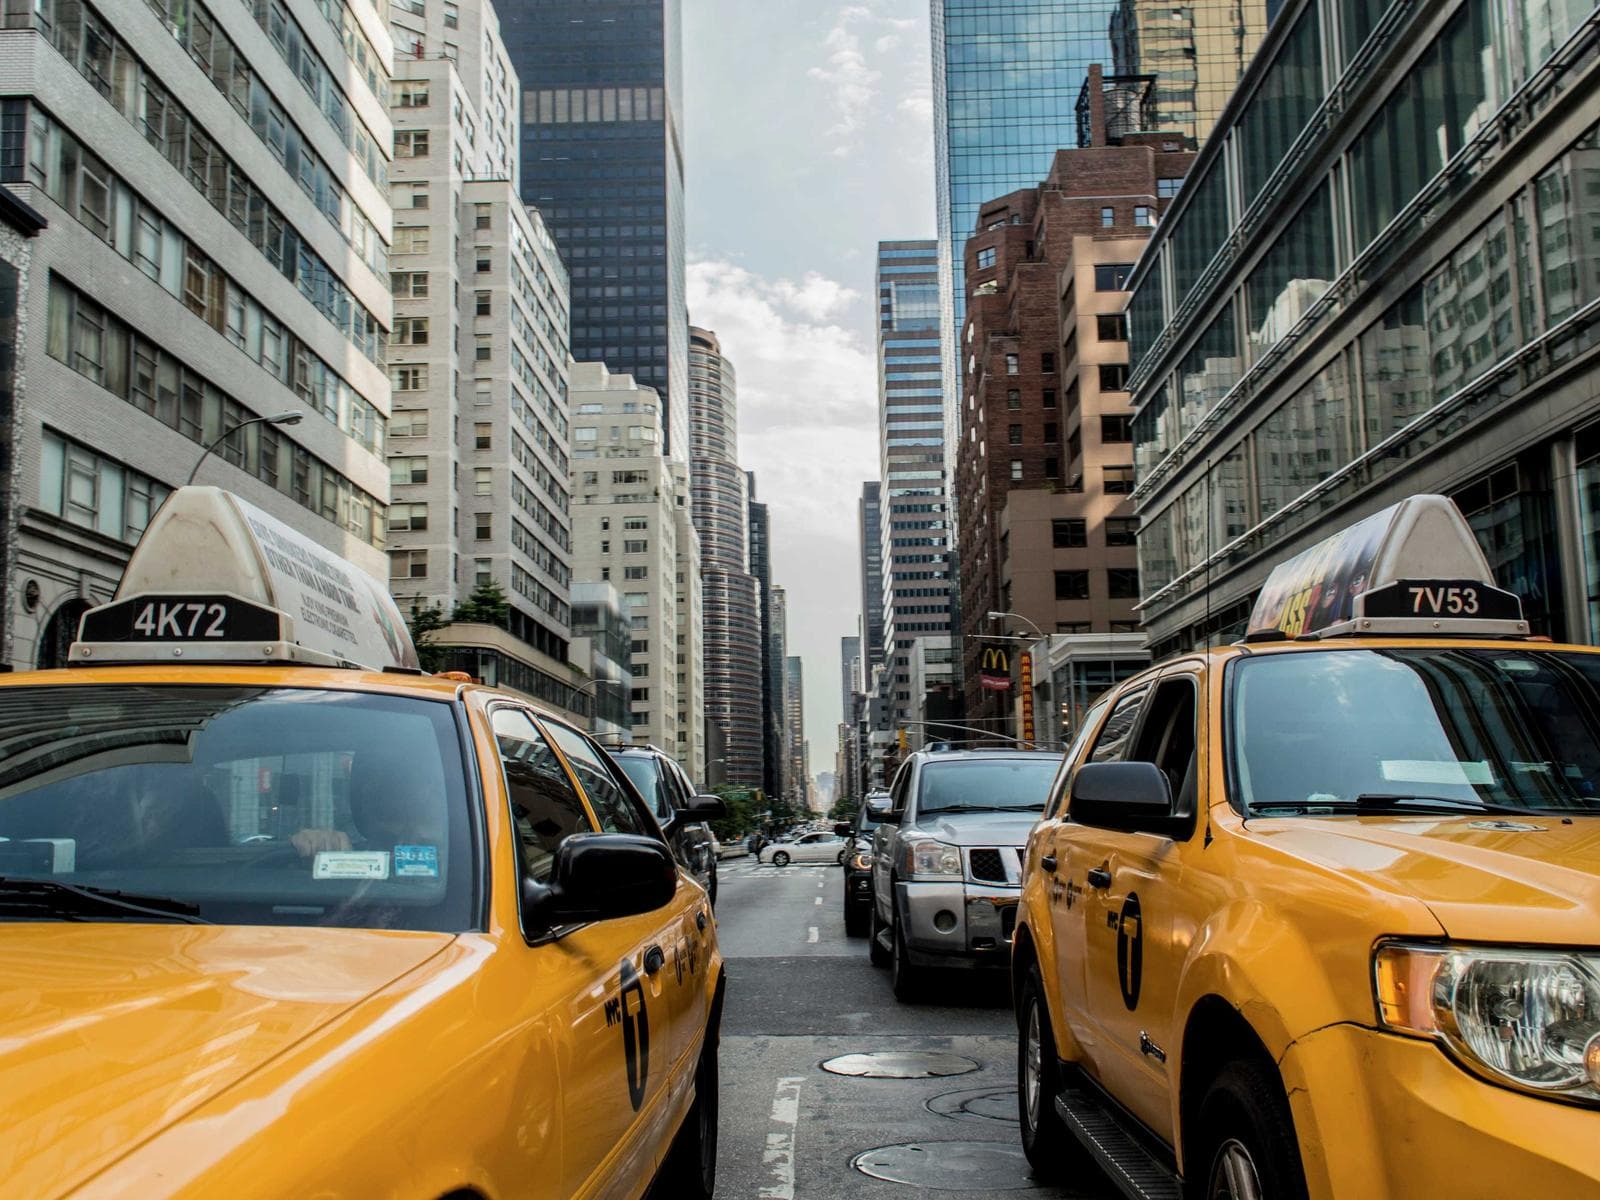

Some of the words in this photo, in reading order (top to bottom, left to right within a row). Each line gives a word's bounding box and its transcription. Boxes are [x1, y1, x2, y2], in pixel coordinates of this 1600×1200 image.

[1408, 587, 1479, 614] 7V53
[134, 603, 225, 637] 4K72
[604, 997, 621, 1027] NYC
